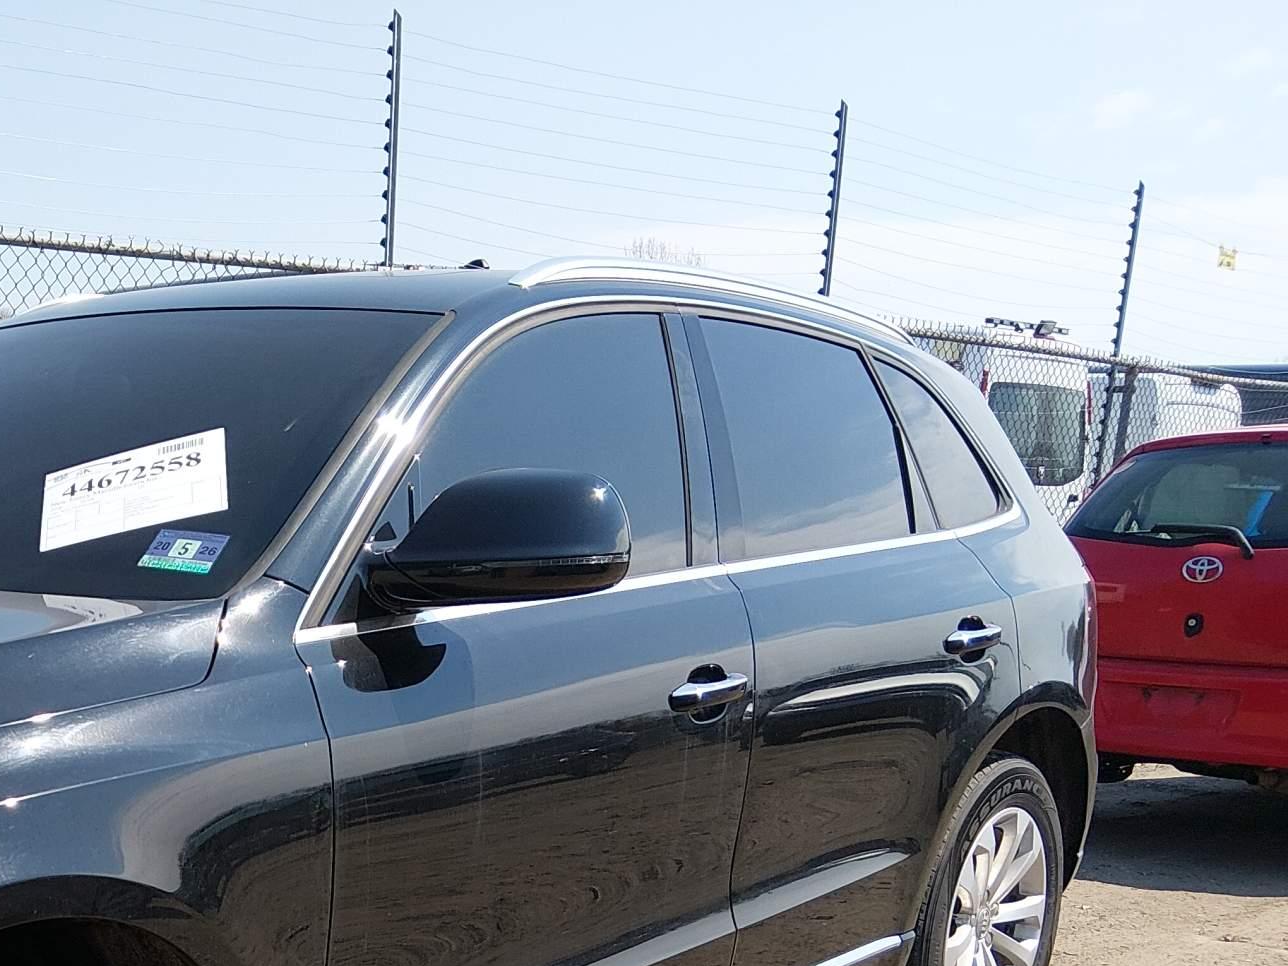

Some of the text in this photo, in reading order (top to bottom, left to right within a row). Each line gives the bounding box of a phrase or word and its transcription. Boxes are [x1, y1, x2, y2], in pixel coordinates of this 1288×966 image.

[62, 451, 202, 497] 44672558
[153, 541, 218, 556] 20 5 26
